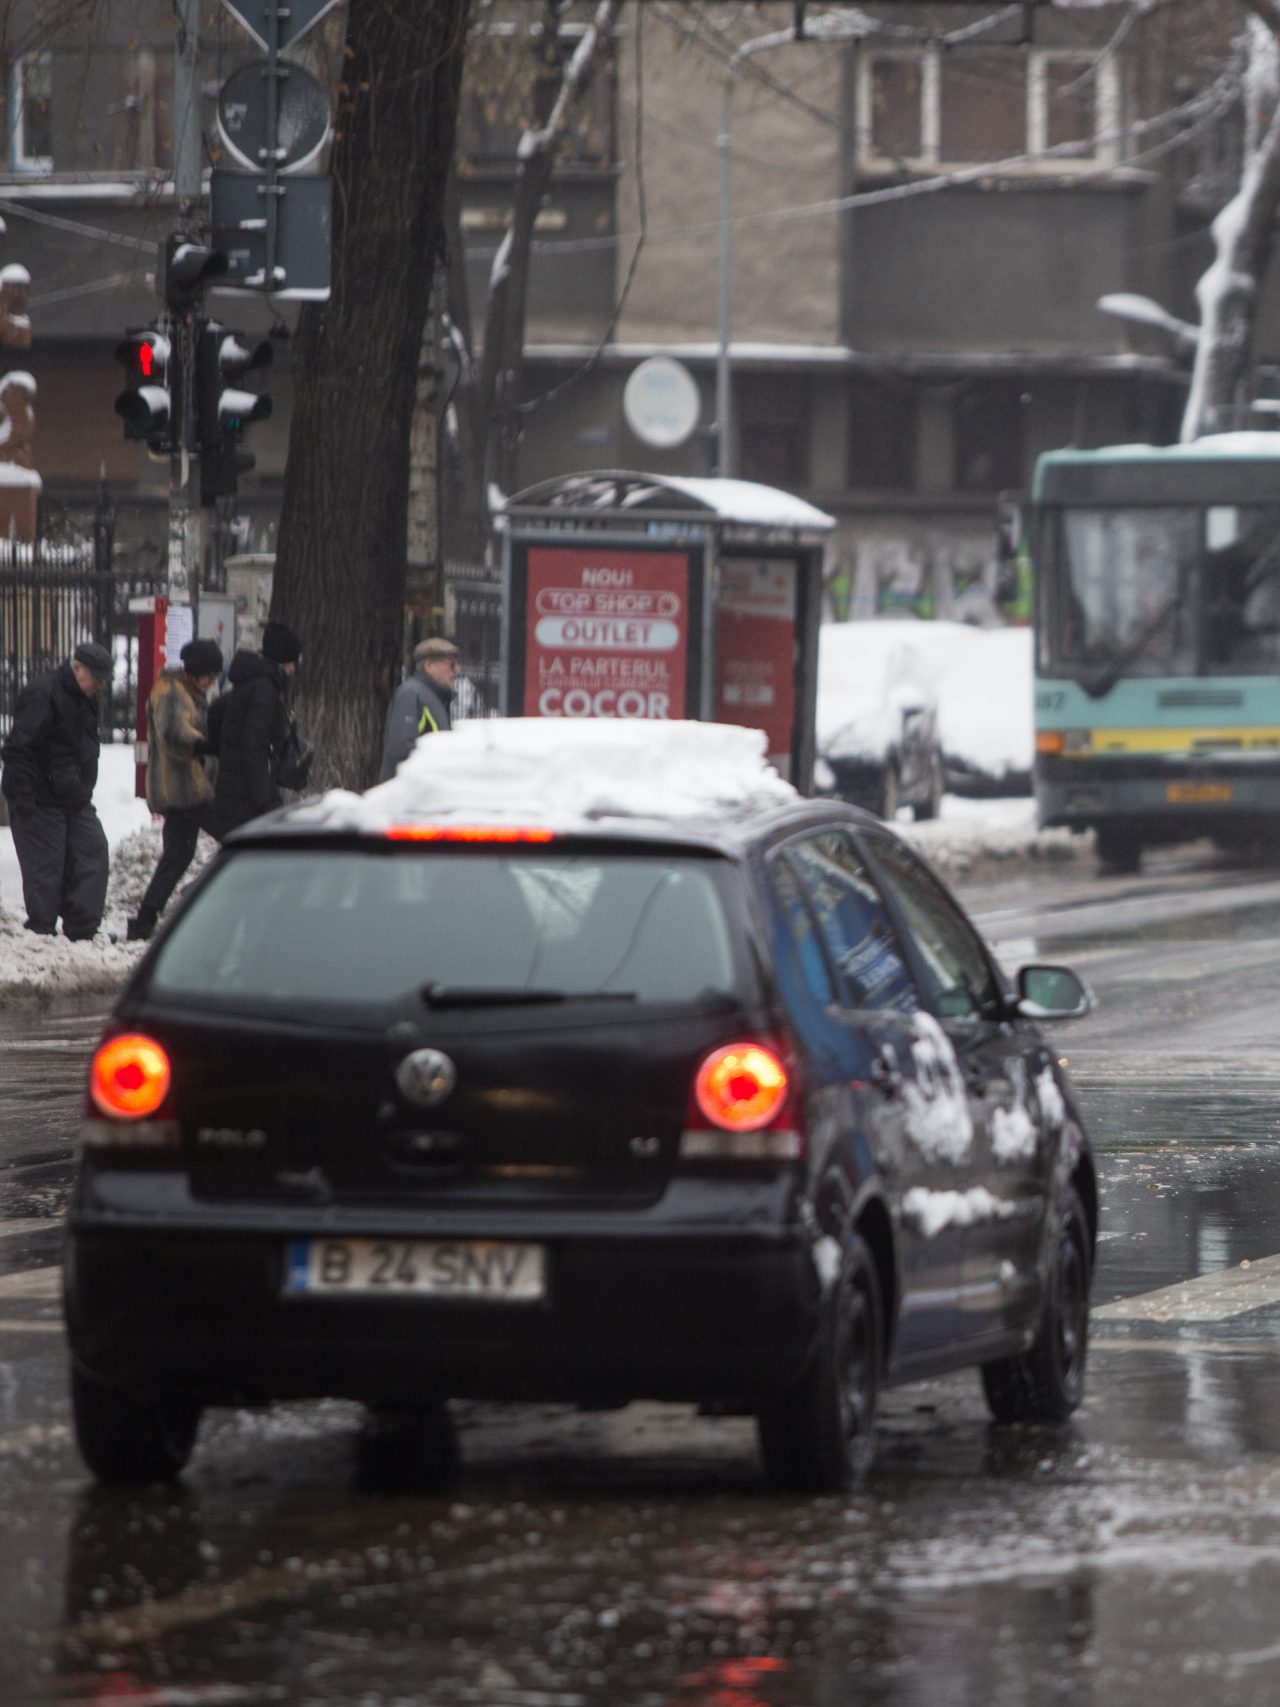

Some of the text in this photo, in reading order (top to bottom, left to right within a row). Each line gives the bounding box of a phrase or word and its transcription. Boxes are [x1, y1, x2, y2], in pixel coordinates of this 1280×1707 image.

[582, 568, 634, 585] NOU!
[551, 593, 651, 612] TOP SHOP
[562, 621, 650, 642] OUTLET
[539, 656, 670, 677] LA PARTERUL
[539, 688, 670, 718] COCOR
[319, 1243, 526, 1287] B 24 SNV
